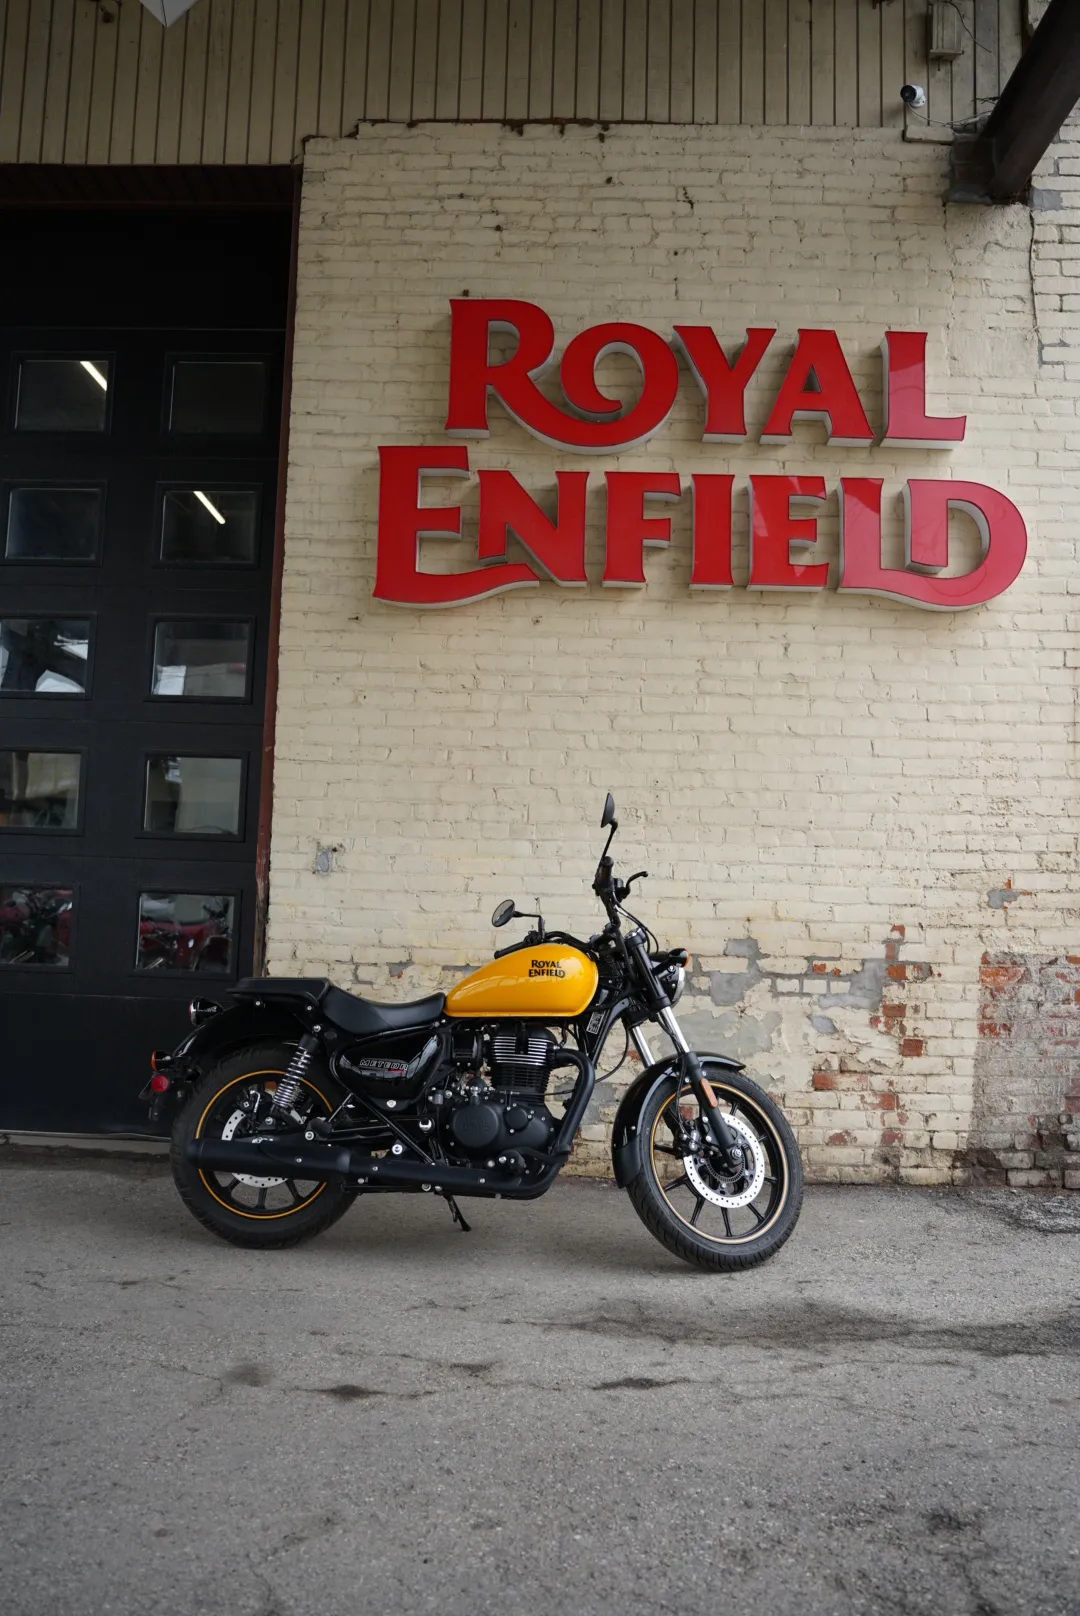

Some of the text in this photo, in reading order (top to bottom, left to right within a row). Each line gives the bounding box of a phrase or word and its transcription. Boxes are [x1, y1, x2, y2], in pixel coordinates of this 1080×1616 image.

[445, 298, 967, 455] ROYAL
[373, 446, 1028, 611] ENFIELD
[528, 968, 566, 979] ENFIELD
[531, 959, 562, 968] ROYAL
